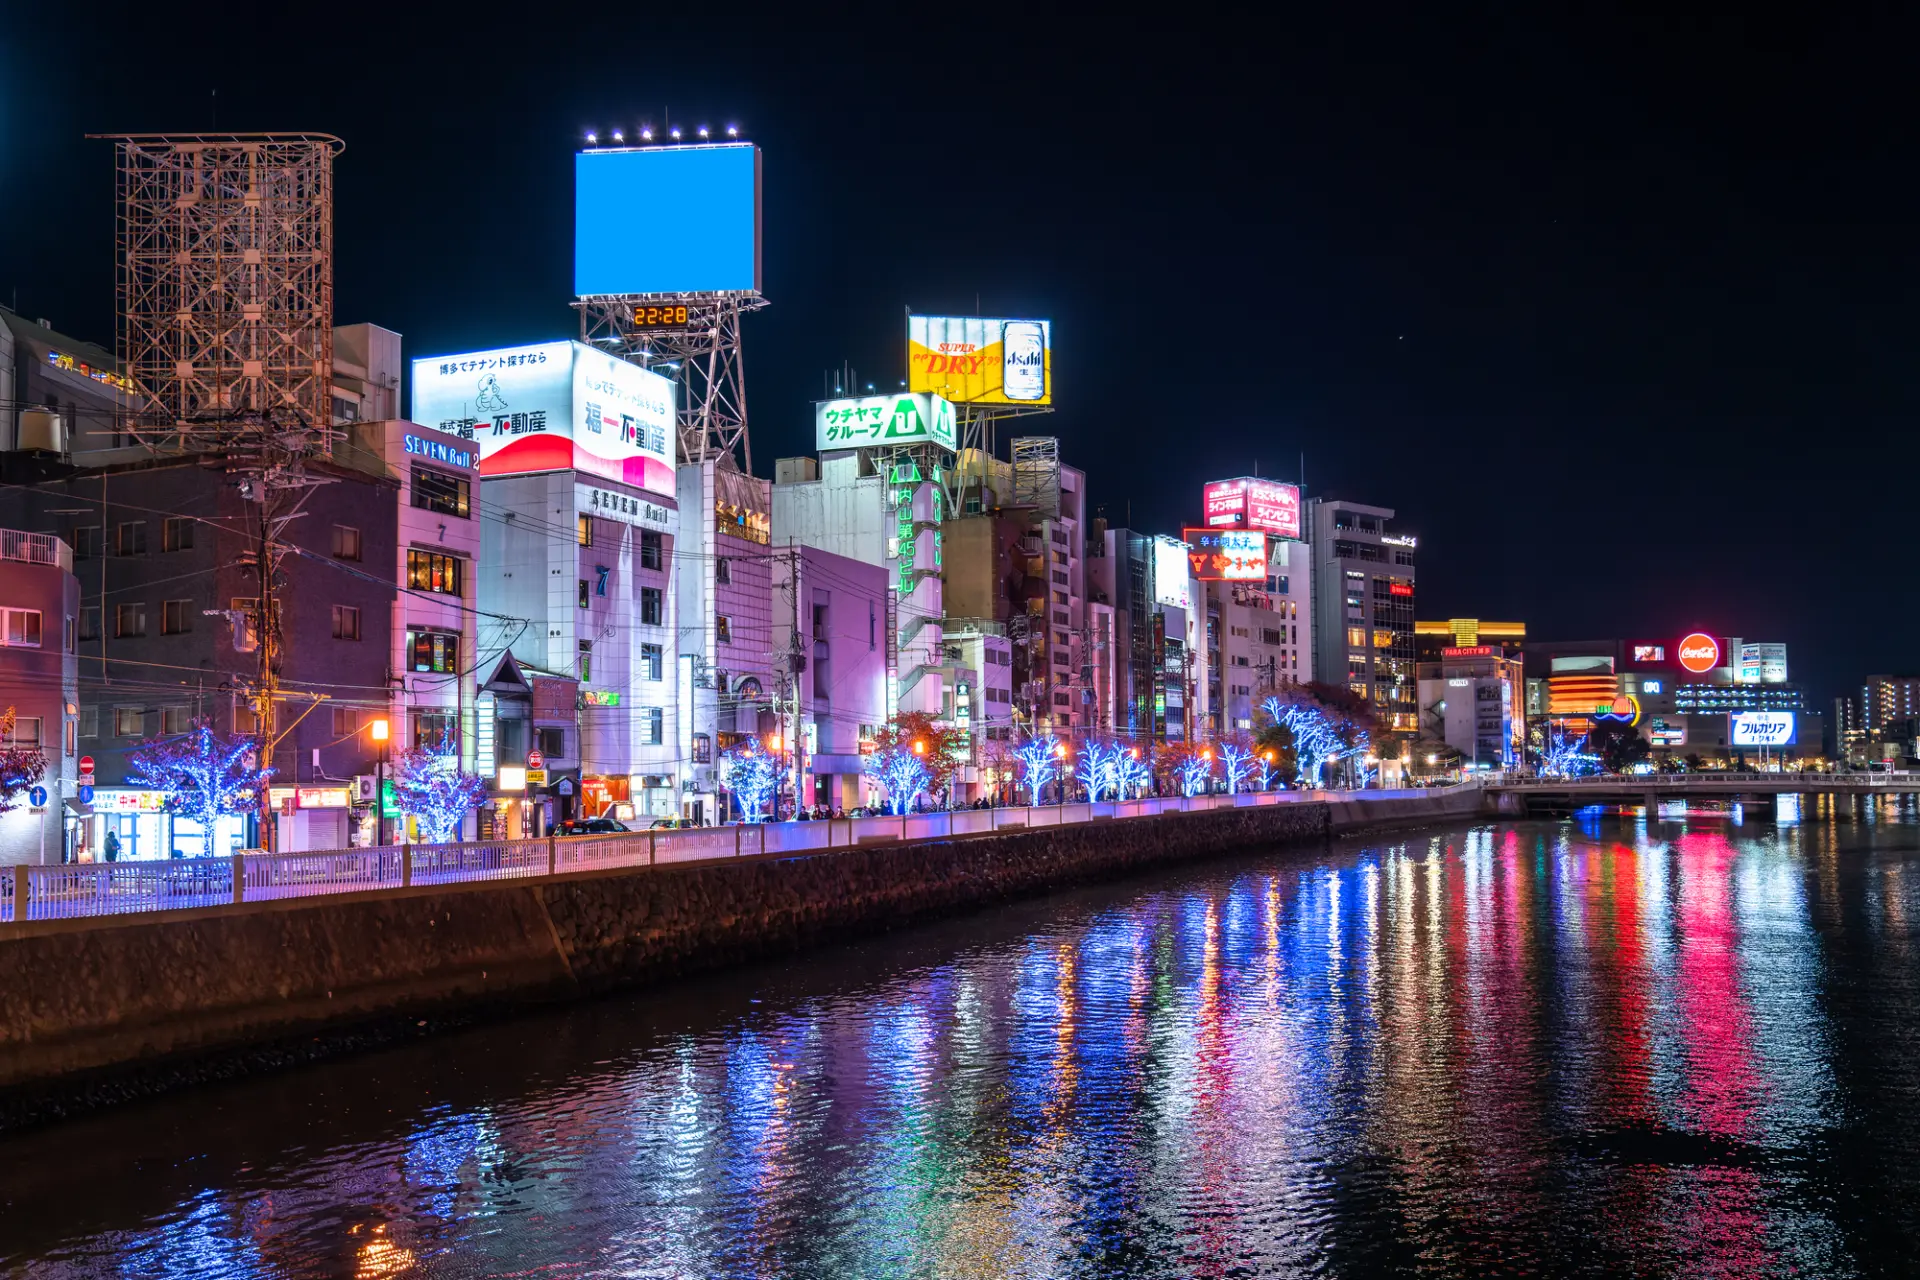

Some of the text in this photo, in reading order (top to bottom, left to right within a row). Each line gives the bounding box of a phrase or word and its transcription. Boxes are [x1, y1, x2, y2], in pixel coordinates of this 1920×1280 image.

[634, 308, 687, 325] 22:28
[938, 343, 976, 353] SUPER
[1007, 351, 1041, 366] Asahi
[440, 352, 547, 376] 博多でテナント探すなら
[457, 411, 547, 440] 福一不動産
[585, 401, 665, 455] 福一不動産
[826, 407, 883, 425] ウチヤマ
[826, 421, 884, 442] グループ
[404, 434, 480, 471] SEVEN Buil 2
[591, 489, 668, 524] SEVEN Buil
[1257, 507, 1291, 522] ラインビル
[898, 487, 915, 593] 内山第45ビル
[594, 565, 611, 597] 7
